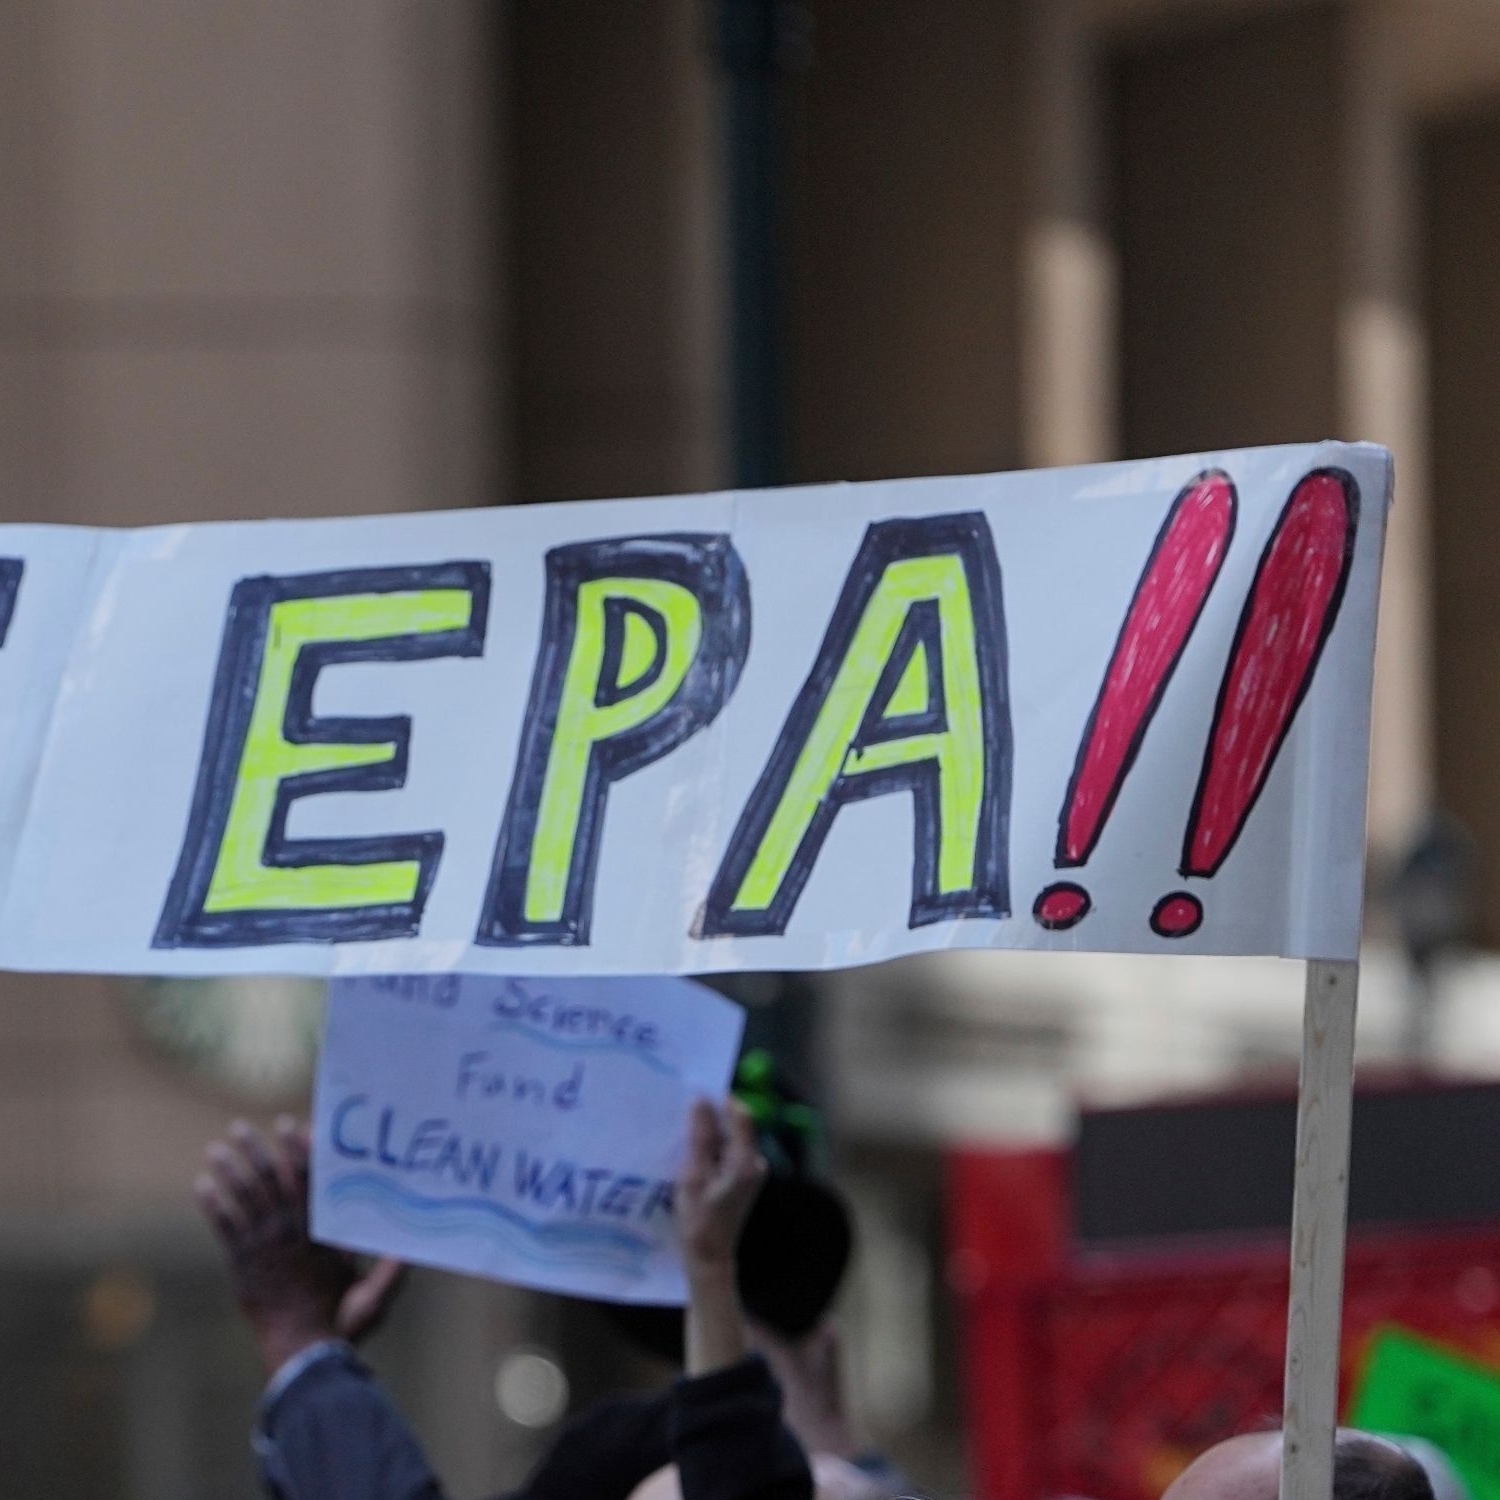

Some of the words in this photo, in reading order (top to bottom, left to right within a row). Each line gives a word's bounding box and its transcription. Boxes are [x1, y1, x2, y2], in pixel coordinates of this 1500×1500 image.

[153, 466, 1359, 949] EPA!!
[455, 1050, 585, 1112] Fund
[330, 1093, 502, 1193] CLEAN
[512, 1149, 677, 1219] WATER
